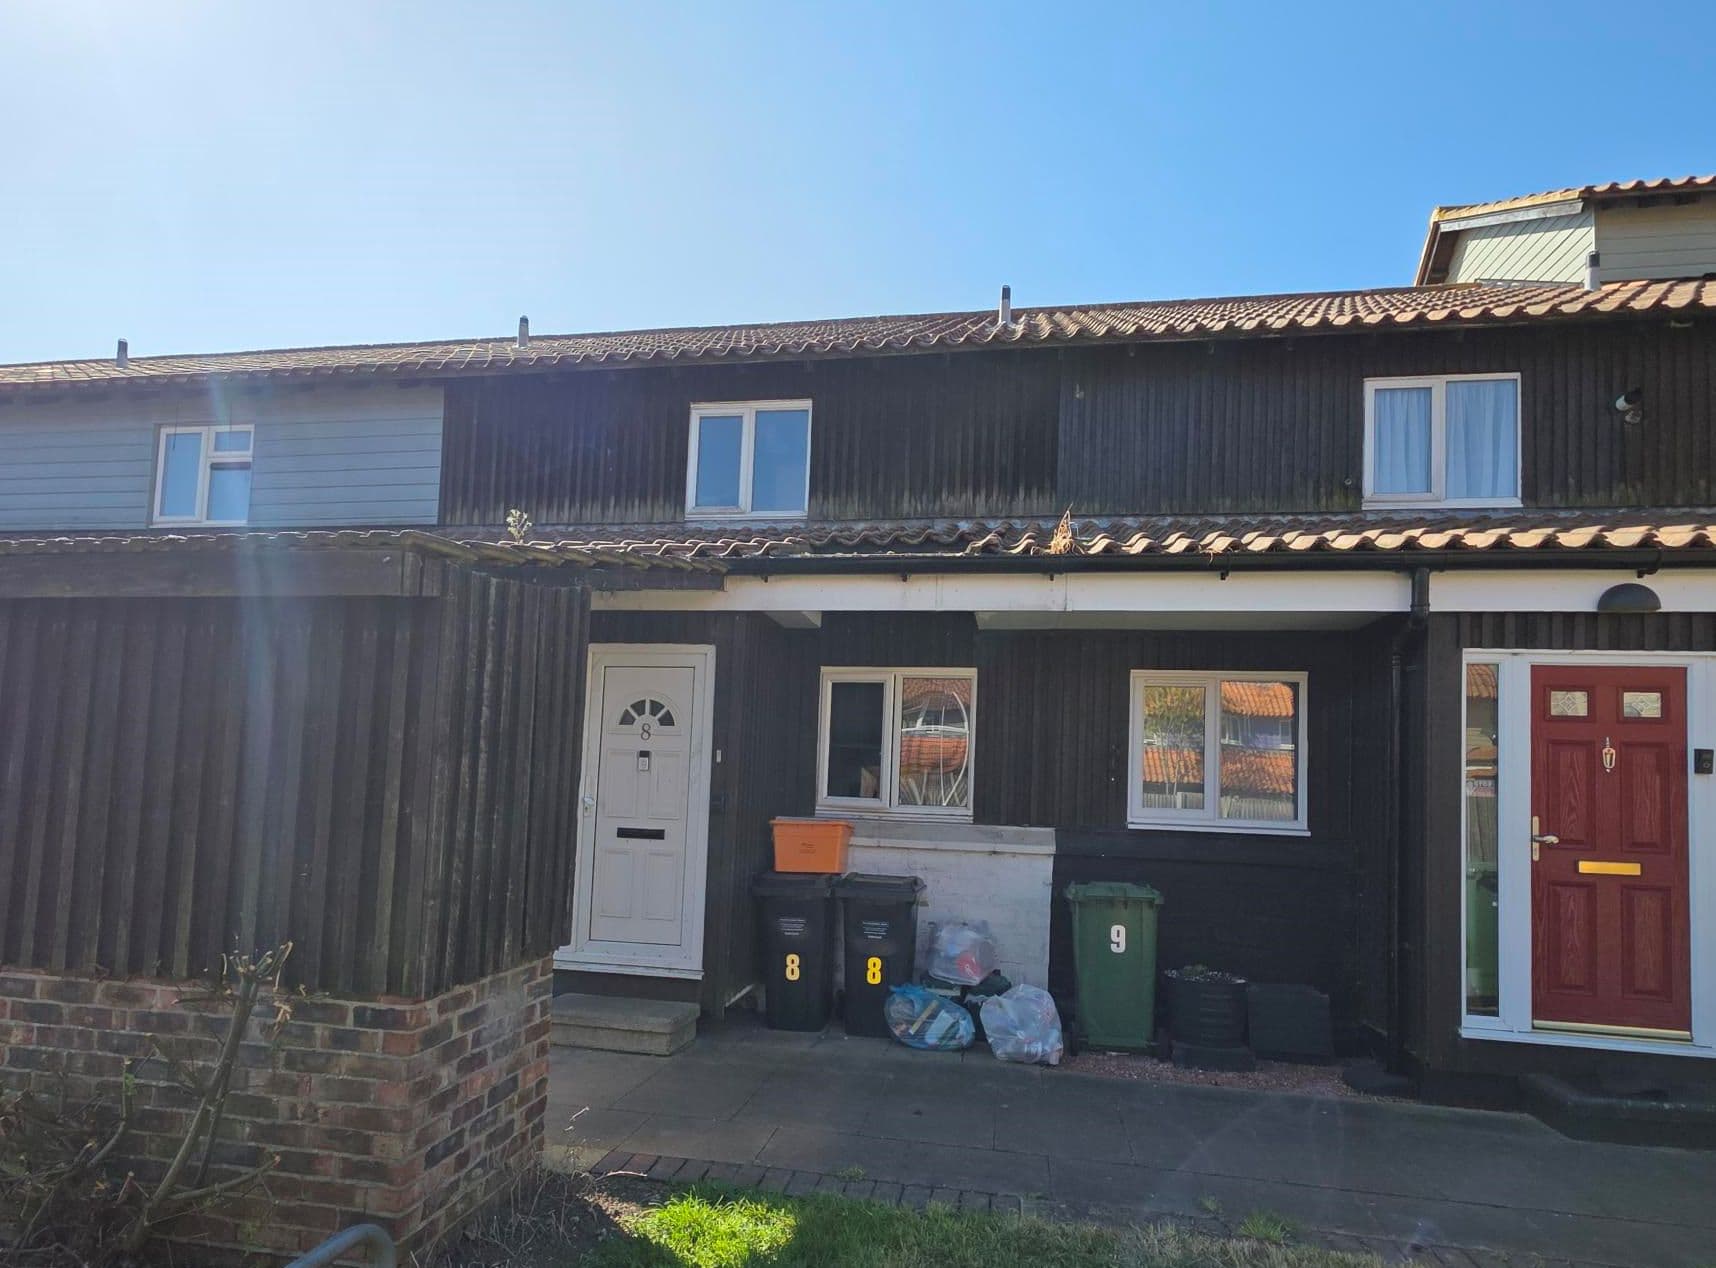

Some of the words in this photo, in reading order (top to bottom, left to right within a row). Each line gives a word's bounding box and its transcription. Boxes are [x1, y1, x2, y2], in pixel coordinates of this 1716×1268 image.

[641, 723, 651, 740] 8
[1110, 924, 1126, 953] 9
[785, 953, 800, 981] 8
[867, 956, 882, 985] 8
